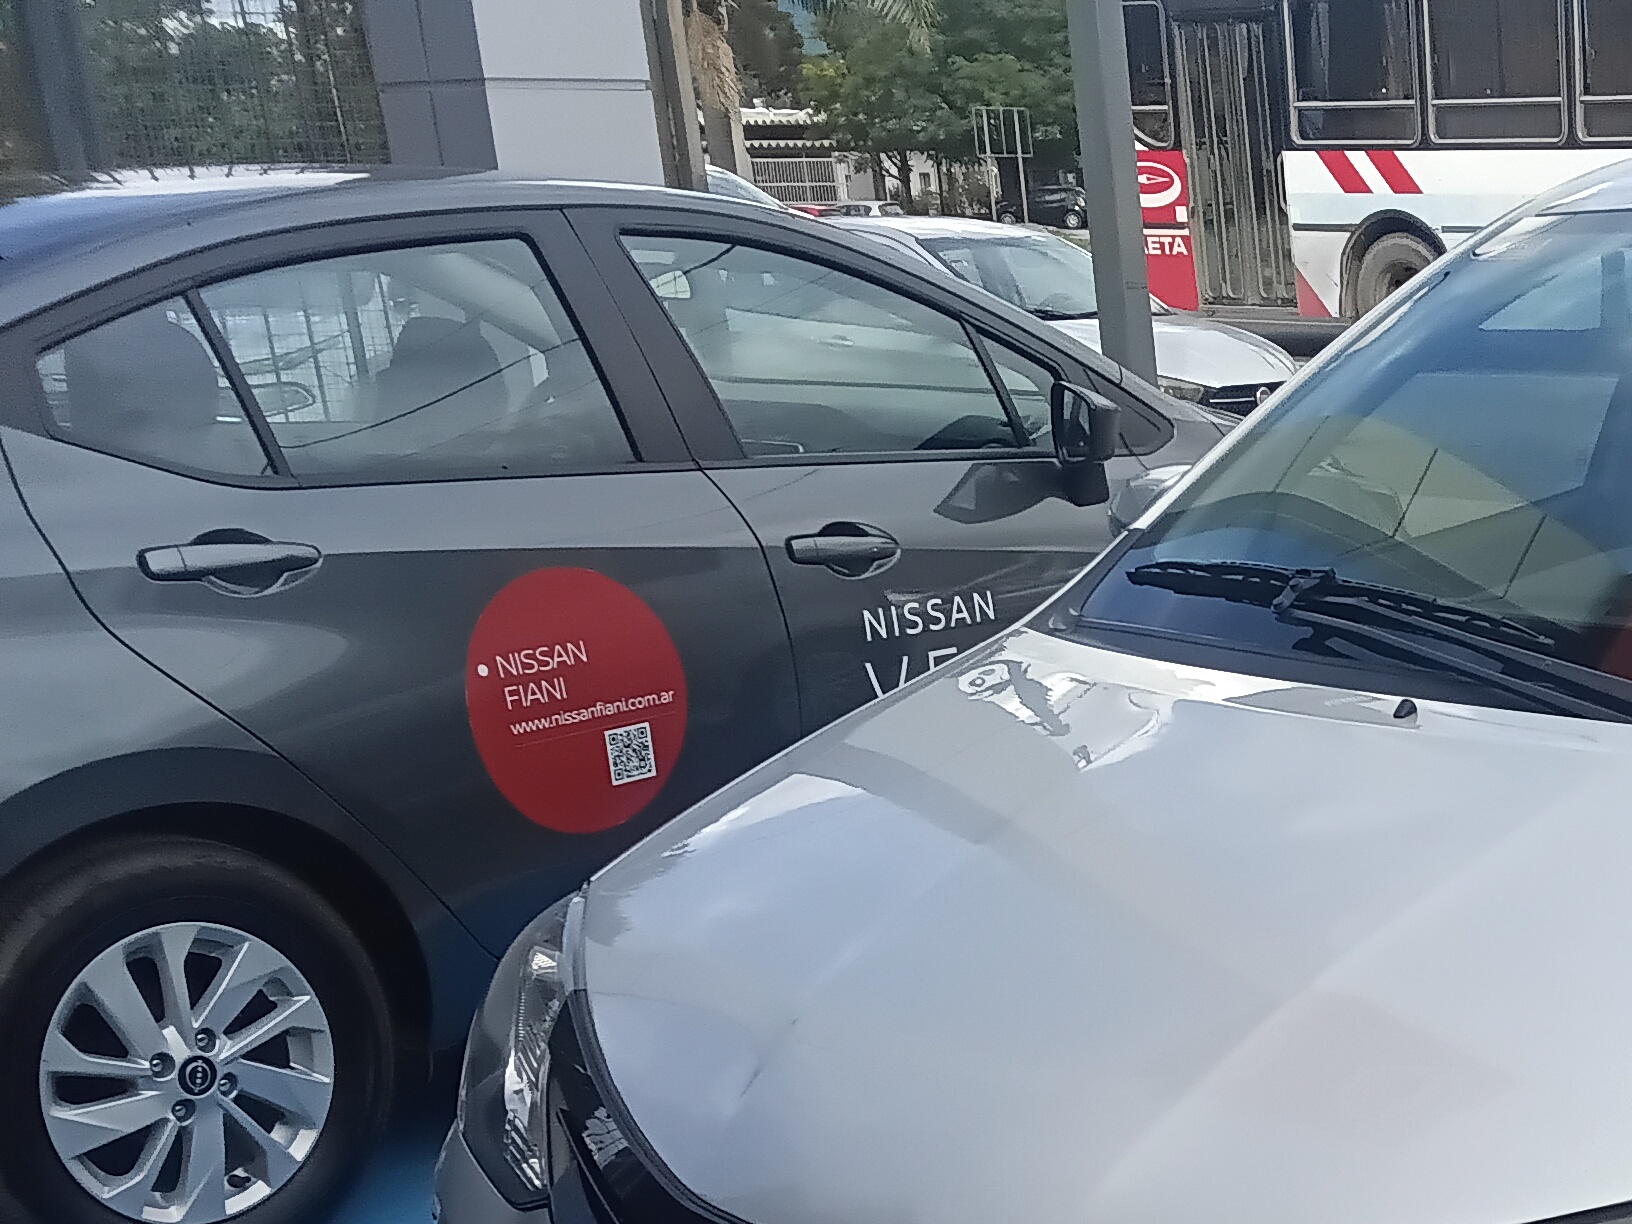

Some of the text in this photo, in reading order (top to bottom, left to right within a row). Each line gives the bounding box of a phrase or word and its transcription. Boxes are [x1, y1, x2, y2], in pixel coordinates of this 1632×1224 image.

[1145, 236, 1188, 255] ETA
[862, 590, 996, 642] NISSAN
[495, 640, 588, 678] NISSAN
[504, 677, 568, 711] FIANI
[510, 690, 675, 735] www.nissanfiani.com.ar
